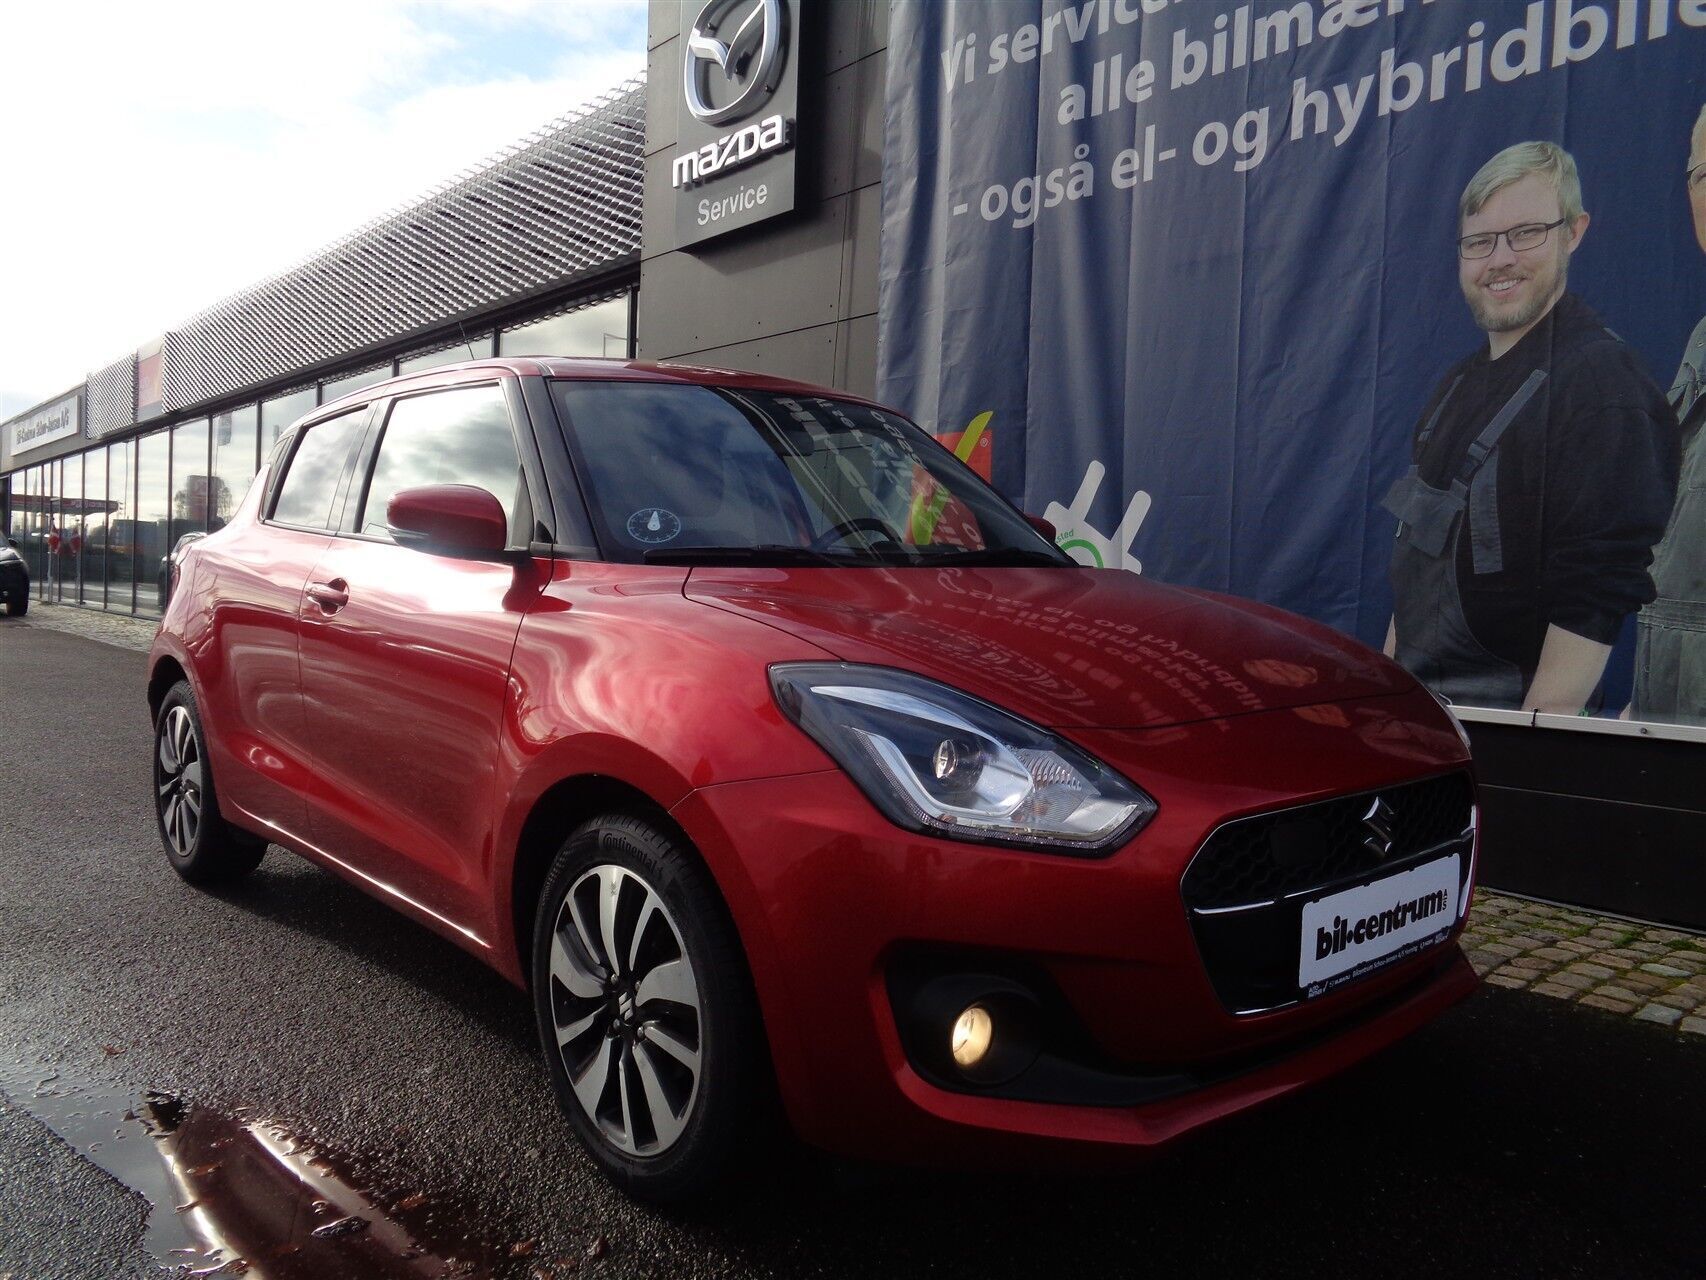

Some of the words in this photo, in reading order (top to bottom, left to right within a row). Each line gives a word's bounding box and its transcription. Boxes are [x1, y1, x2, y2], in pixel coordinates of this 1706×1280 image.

[940, 33, 977, 94] Vi
[1057, 53, 1155, 125] alle
[980, 147, 1093, 230] også
[1110, 125, 1177, 192] el-
[1192, 105, 1271, 173] og
[697, 184, 768, 226] Service
